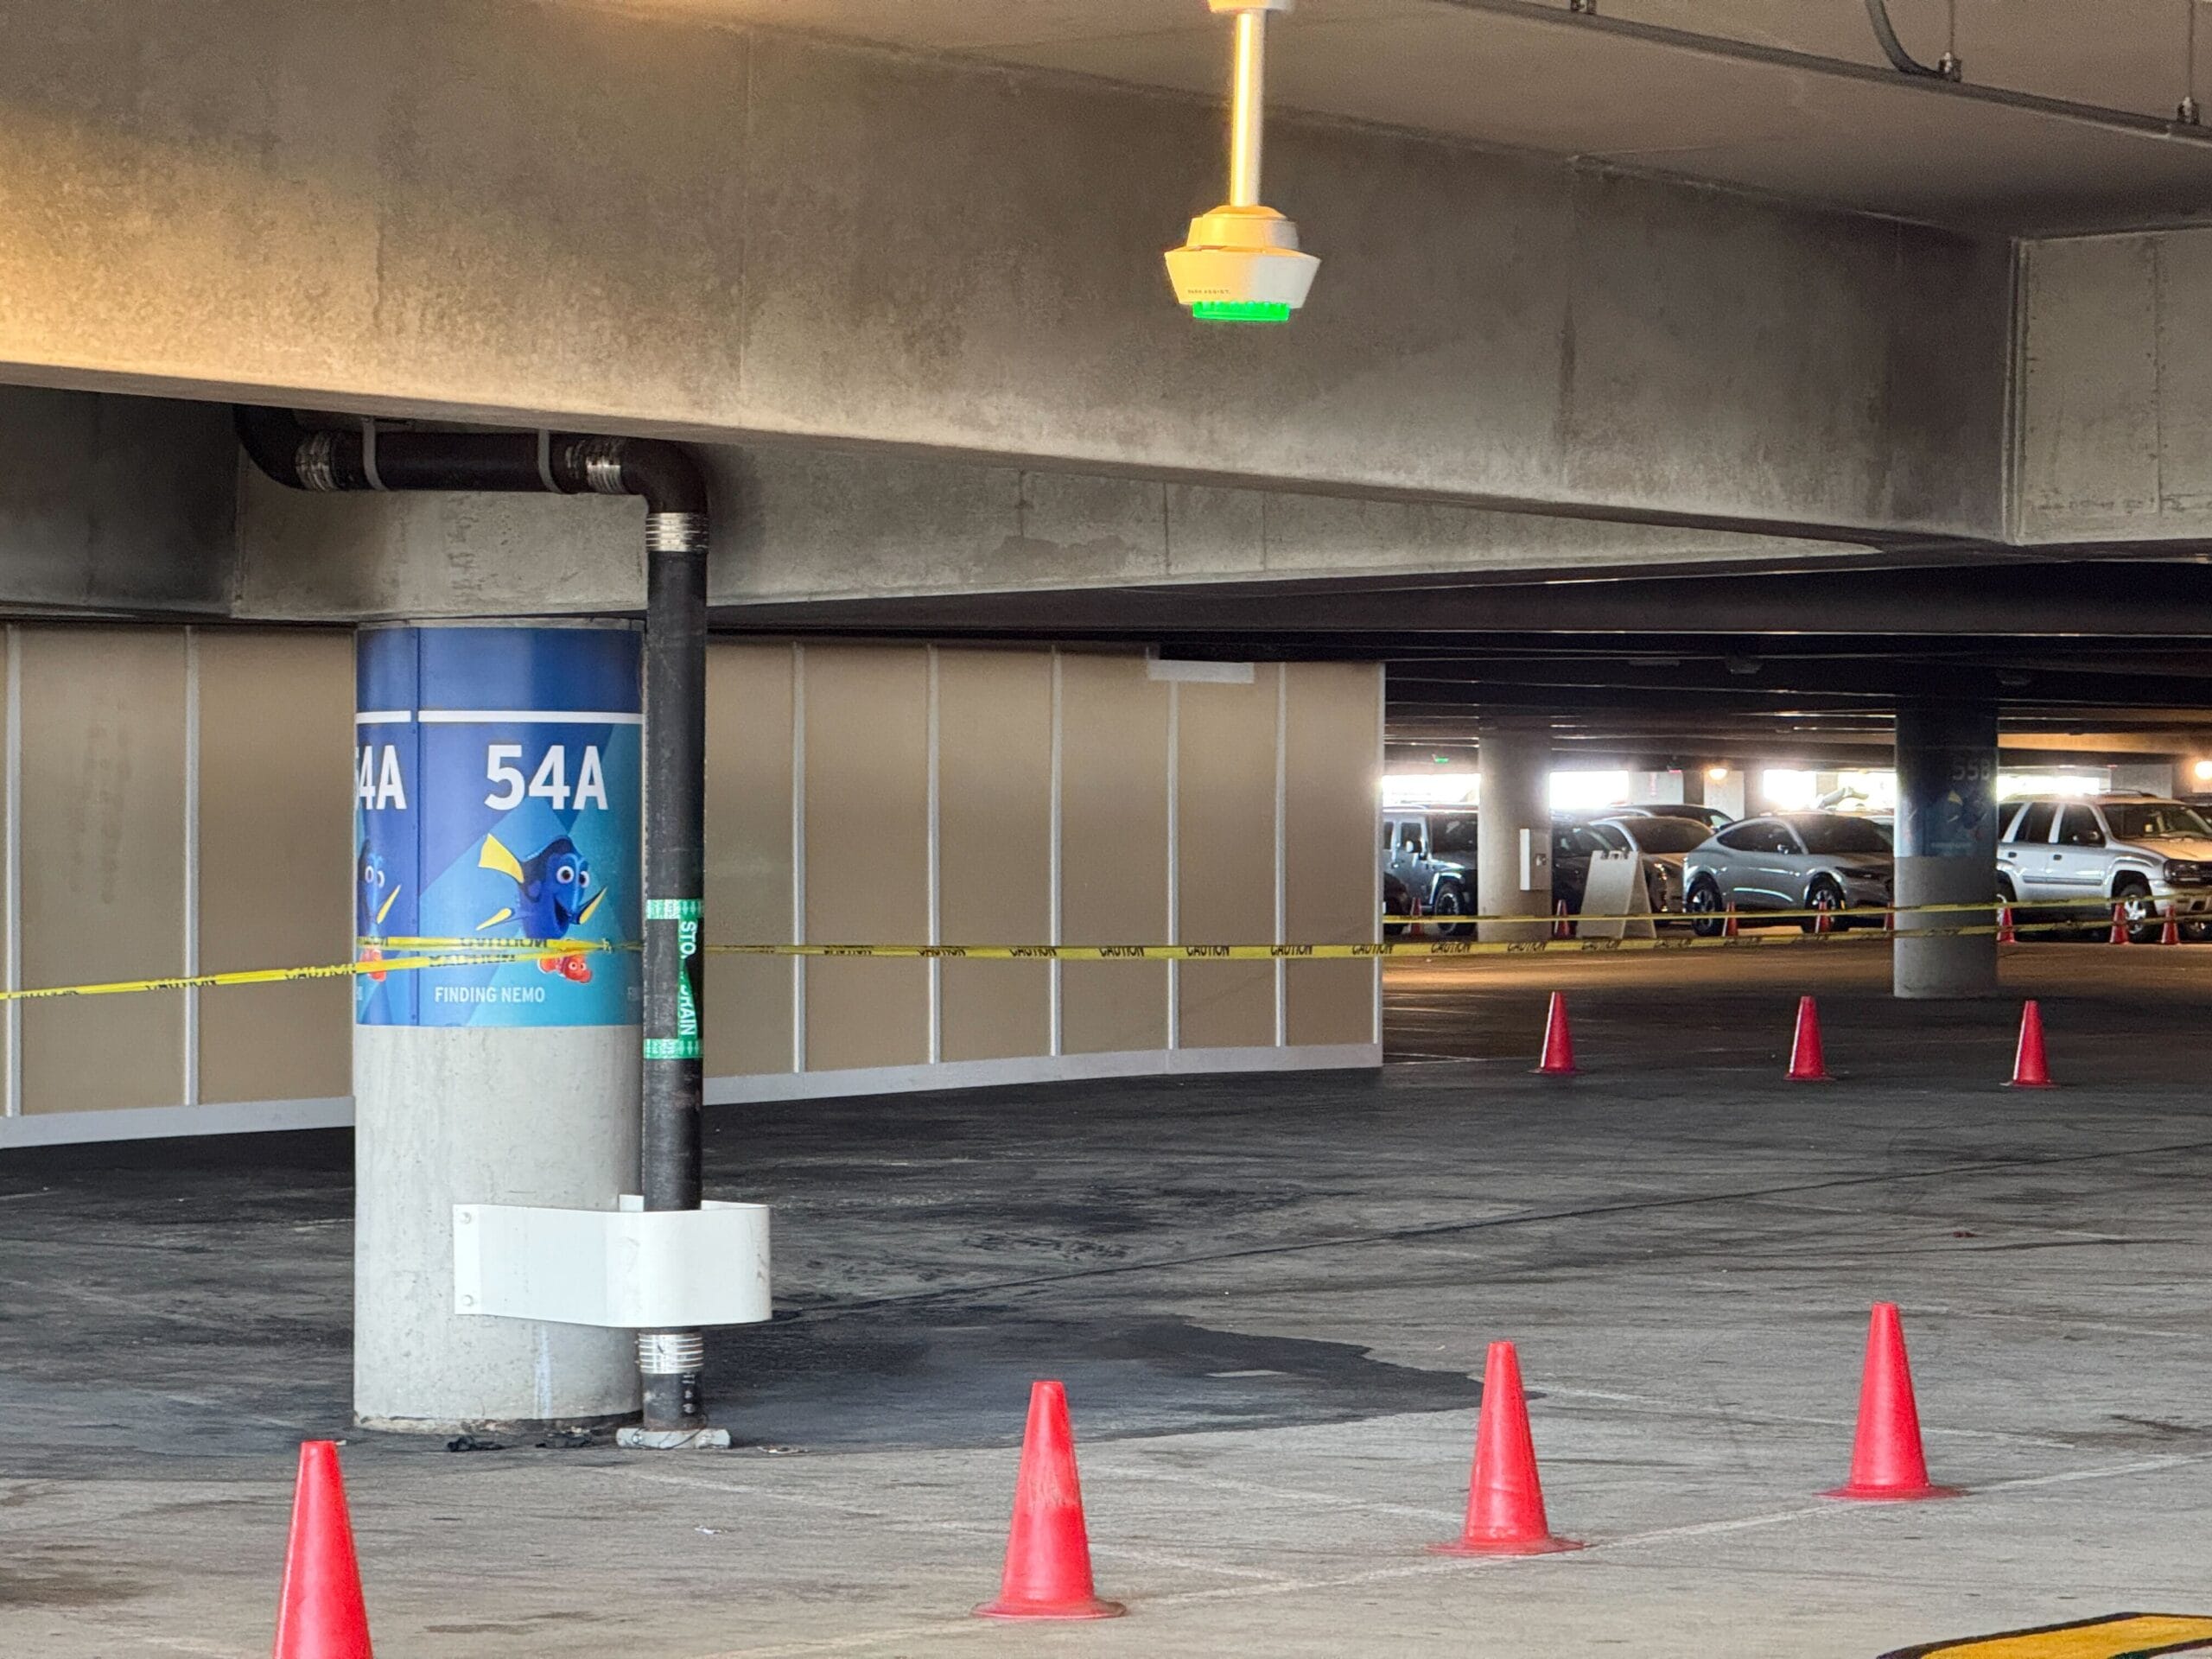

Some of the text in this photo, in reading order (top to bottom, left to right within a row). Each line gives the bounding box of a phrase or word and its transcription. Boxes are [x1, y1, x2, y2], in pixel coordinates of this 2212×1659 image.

[484, 745, 608, 810] 54A
[1099, 946, 1144, 957] CAUTION
[1185, 945, 1230, 957] CAUTION
[1270, 944, 1313, 956] CAUTION
[1351, 944, 1395, 955] CAUTION
[1431, 942, 1471, 954] CAUTION
[435, 987, 545, 1002] FINDING NEMO
